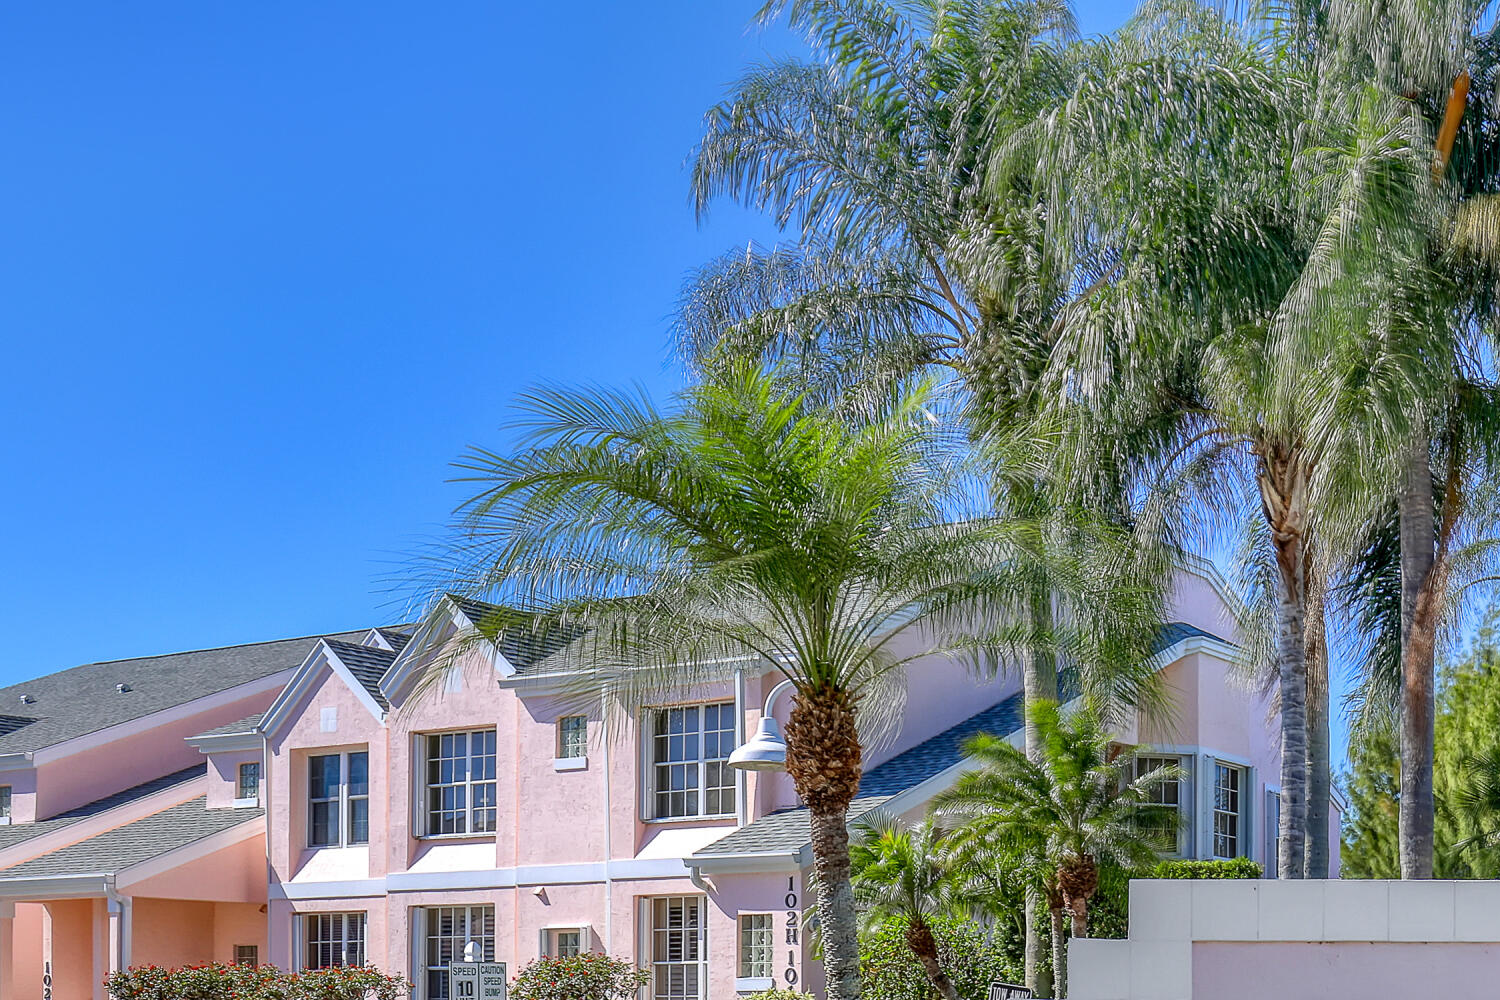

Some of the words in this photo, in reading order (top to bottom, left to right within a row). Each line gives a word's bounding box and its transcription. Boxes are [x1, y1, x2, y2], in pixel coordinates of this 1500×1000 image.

[785, 876, 798, 945] 102H
[453, 967, 476, 976] SPEED
[480, 965, 504, 974] CAUTION
[785, 950, 797, 990] 10
[484, 977, 501, 985] SPEED
[458, 980, 473, 996] 10
[485, 988, 501, 996] BUMP
